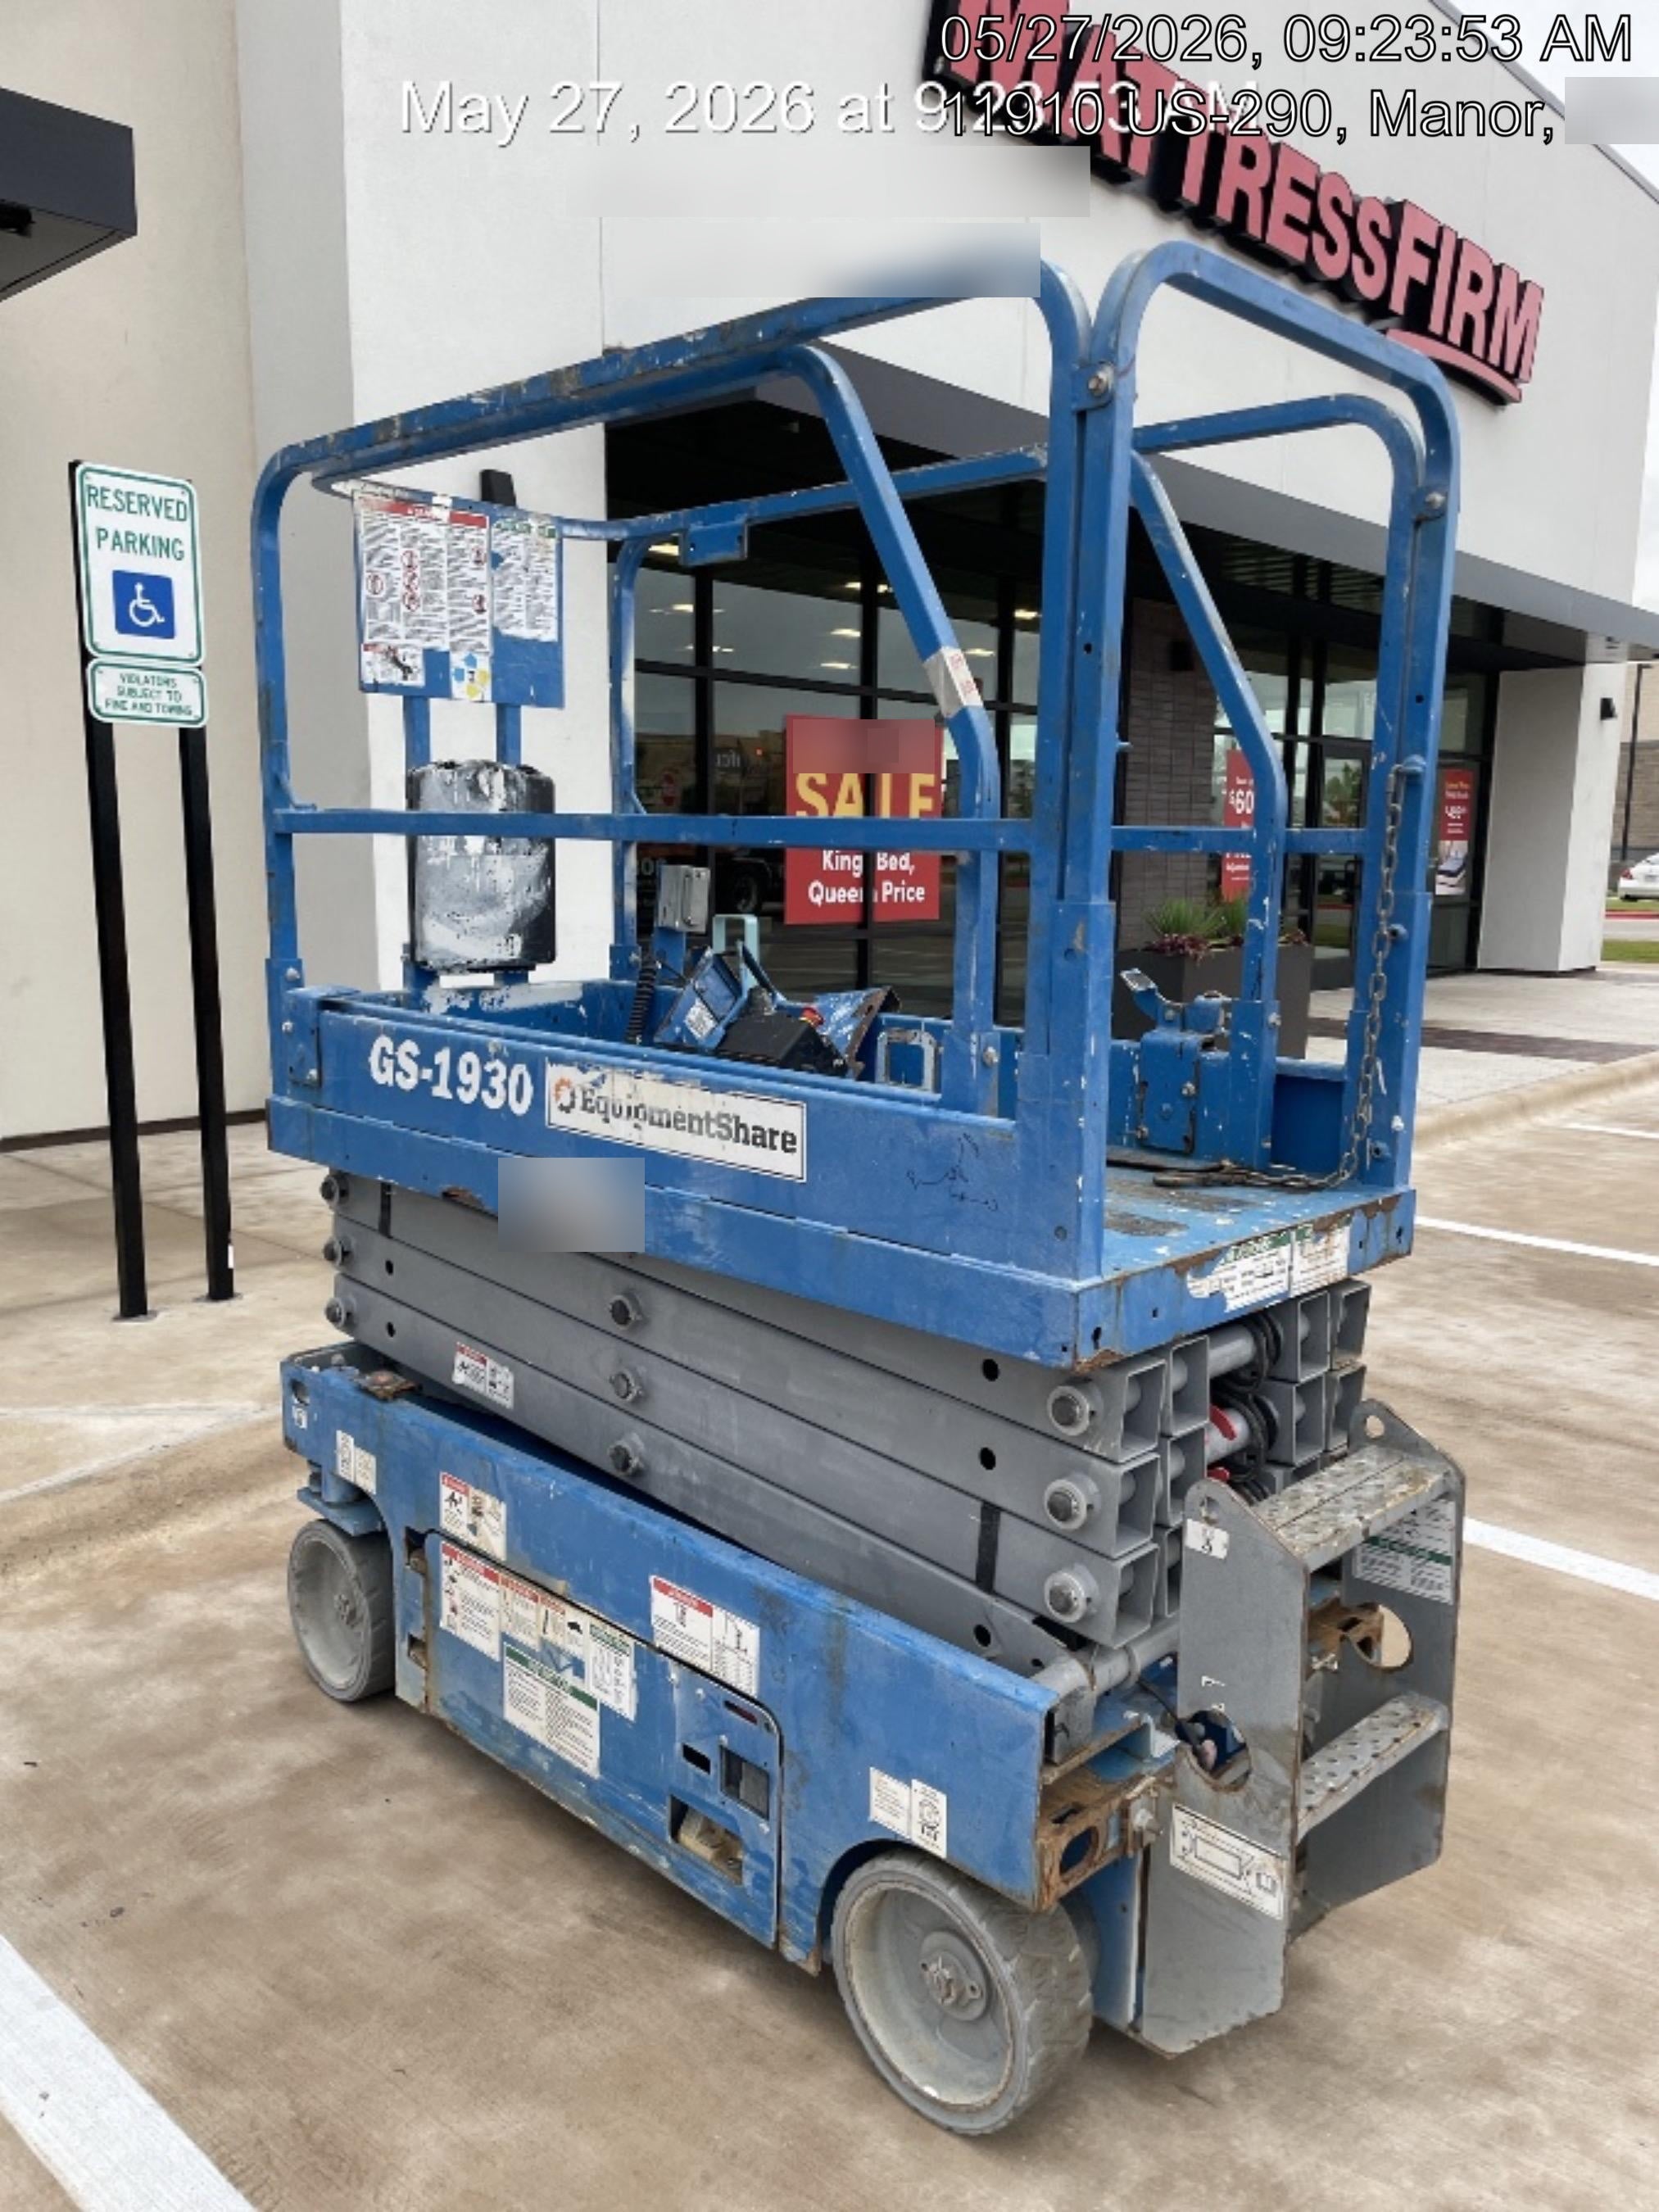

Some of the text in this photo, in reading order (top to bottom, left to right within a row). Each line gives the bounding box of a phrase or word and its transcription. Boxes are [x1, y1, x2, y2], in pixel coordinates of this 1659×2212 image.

[87, 484, 188, 522] RESERVED
[96, 528, 185, 561] PARKING
[166, 690, 183, 703] TO
[823, 850, 915, 877] King Bed,
[882, 882, 926, 902] Price
[368, 1035, 534, 1117] GS-1930
[580, 1086, 799, 1154] EquipmentShare
